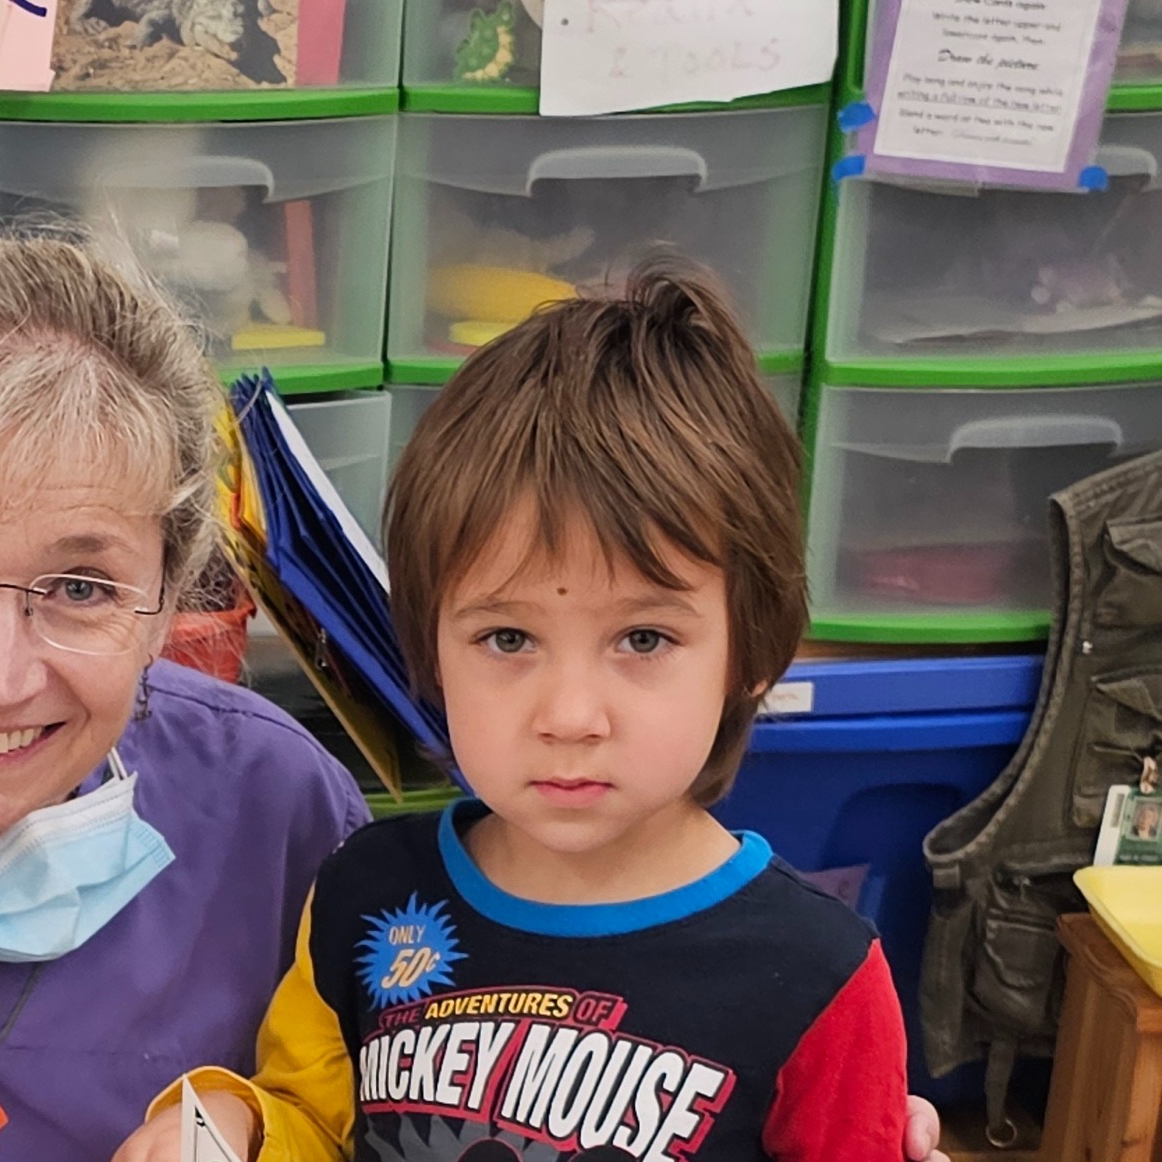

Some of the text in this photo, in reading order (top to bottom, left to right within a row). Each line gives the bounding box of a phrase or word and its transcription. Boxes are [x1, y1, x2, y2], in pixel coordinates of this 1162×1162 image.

[388, 924, 426, 946] ONLY
[384, 993, 613, 1028] THE ADVENTURES OF
[359, 1022, 515, 1110] MICKEY
